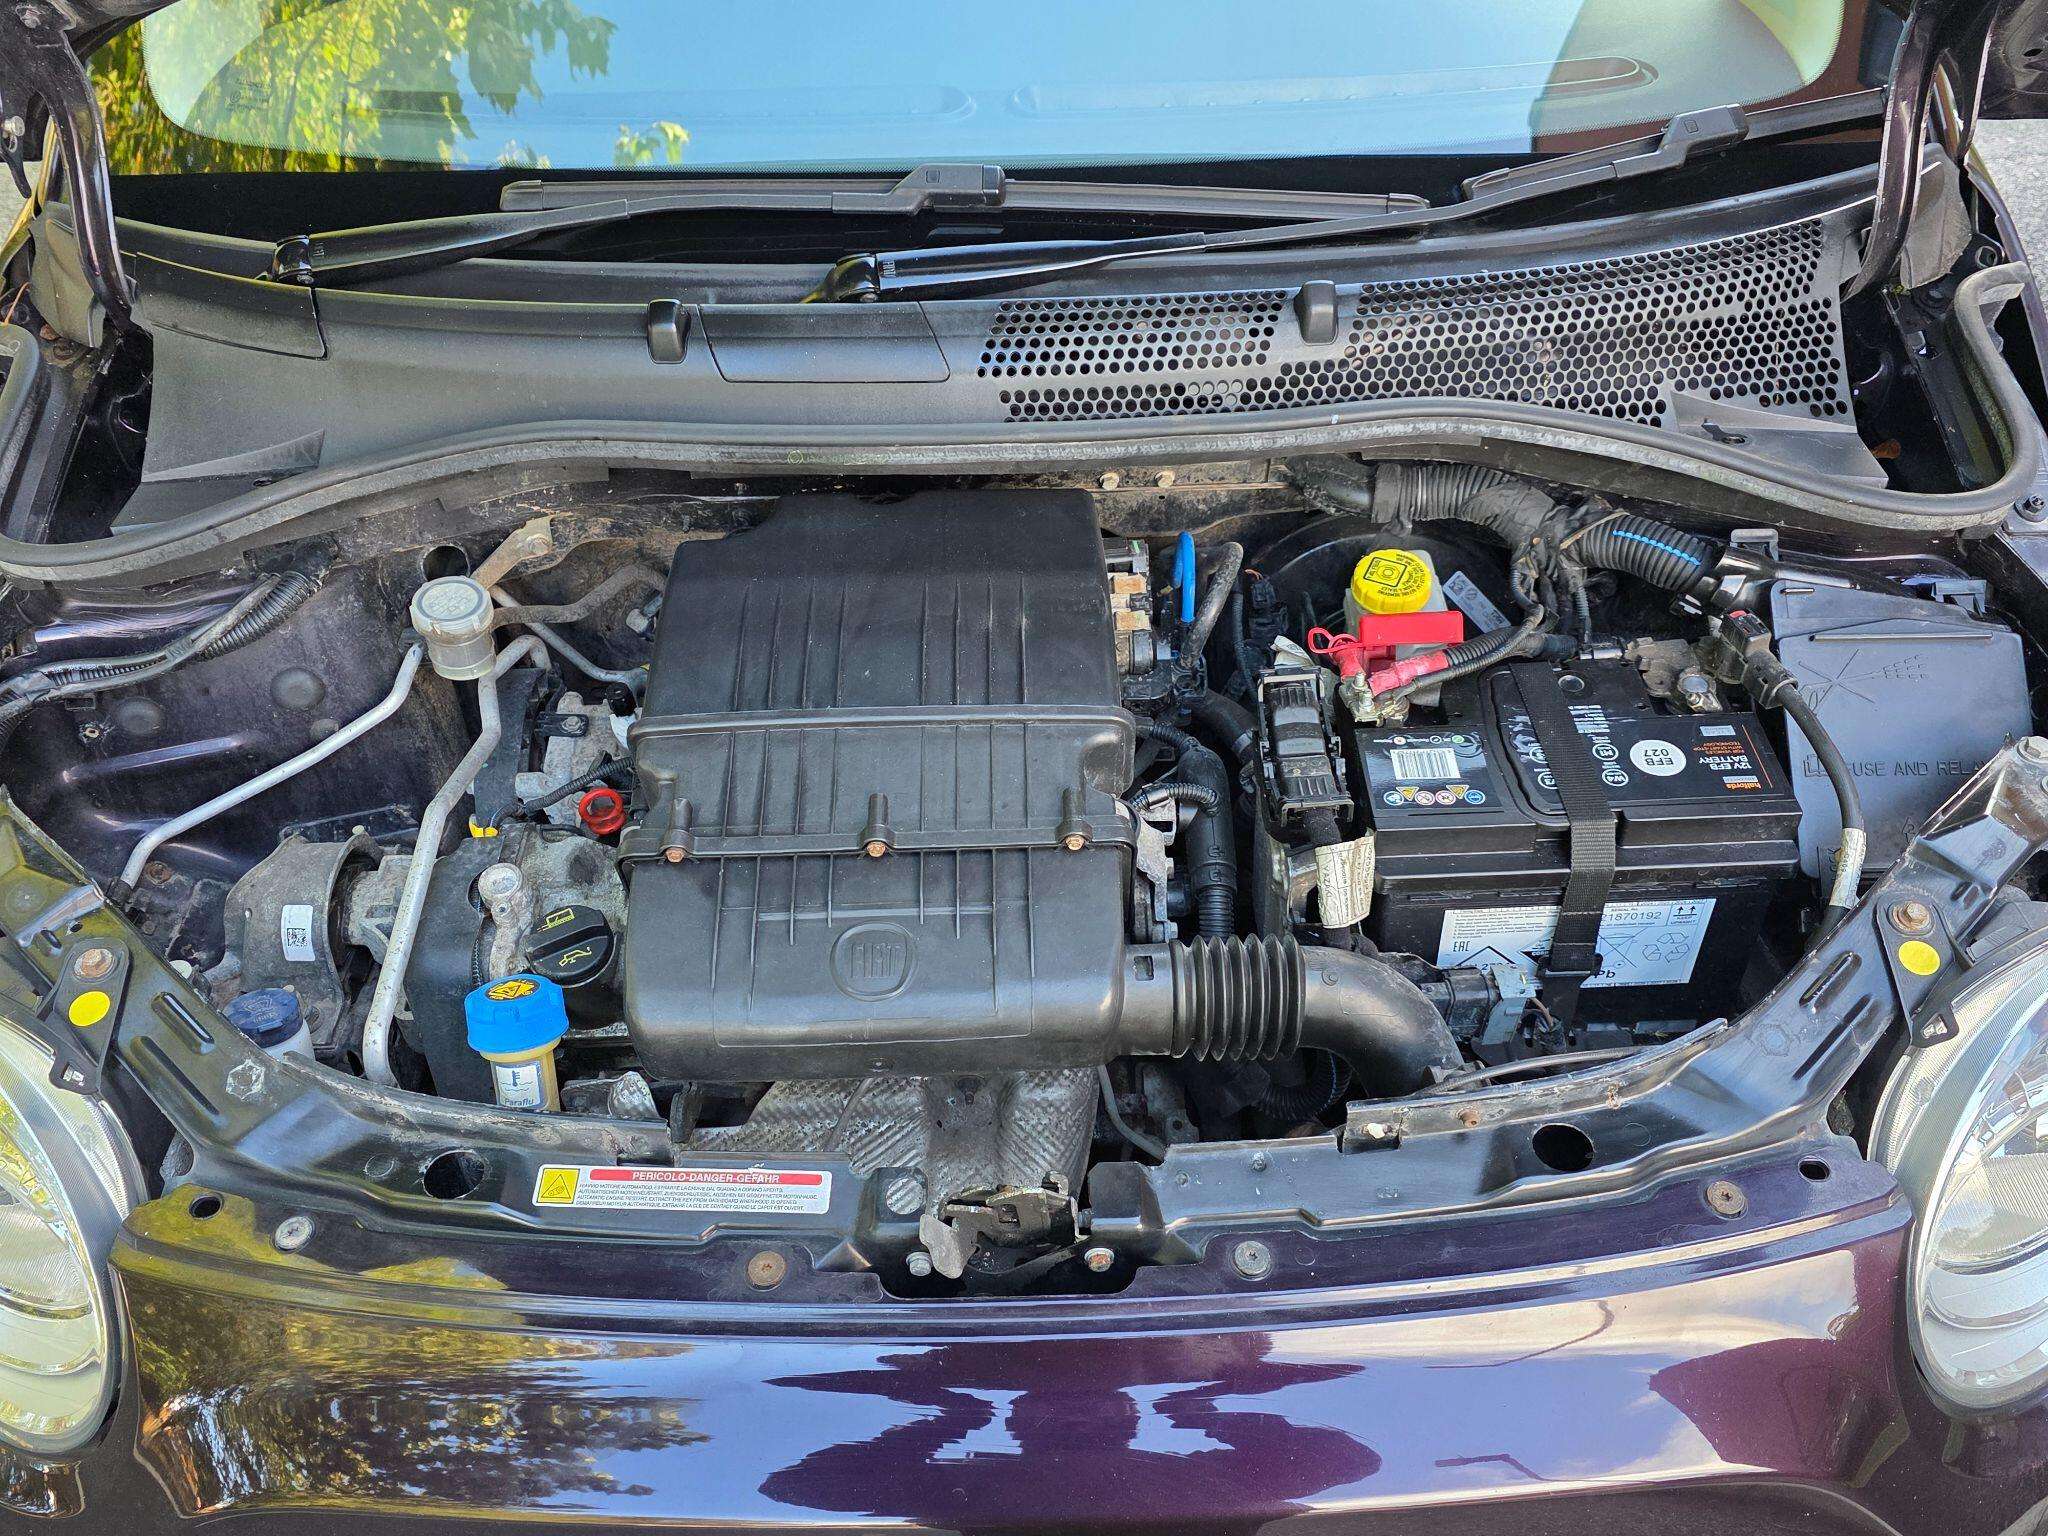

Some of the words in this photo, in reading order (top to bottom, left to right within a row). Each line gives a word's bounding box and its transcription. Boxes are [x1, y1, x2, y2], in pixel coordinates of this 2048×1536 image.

[1643, 748, 1669, 757] 027
[1645, 757, 1674, 766] EFB
[1698, 755, 1748, 763] BATTERY
[1732, 762, 1753, 770] 12V
[1848, 760, 1886, 777] USE
[1894, 761, 1929, 776] AND
[1936, 759, 1985, 776] RELA
[632, 1171, 780, 1183] PERICOLO-DANGER-GEFAHR
